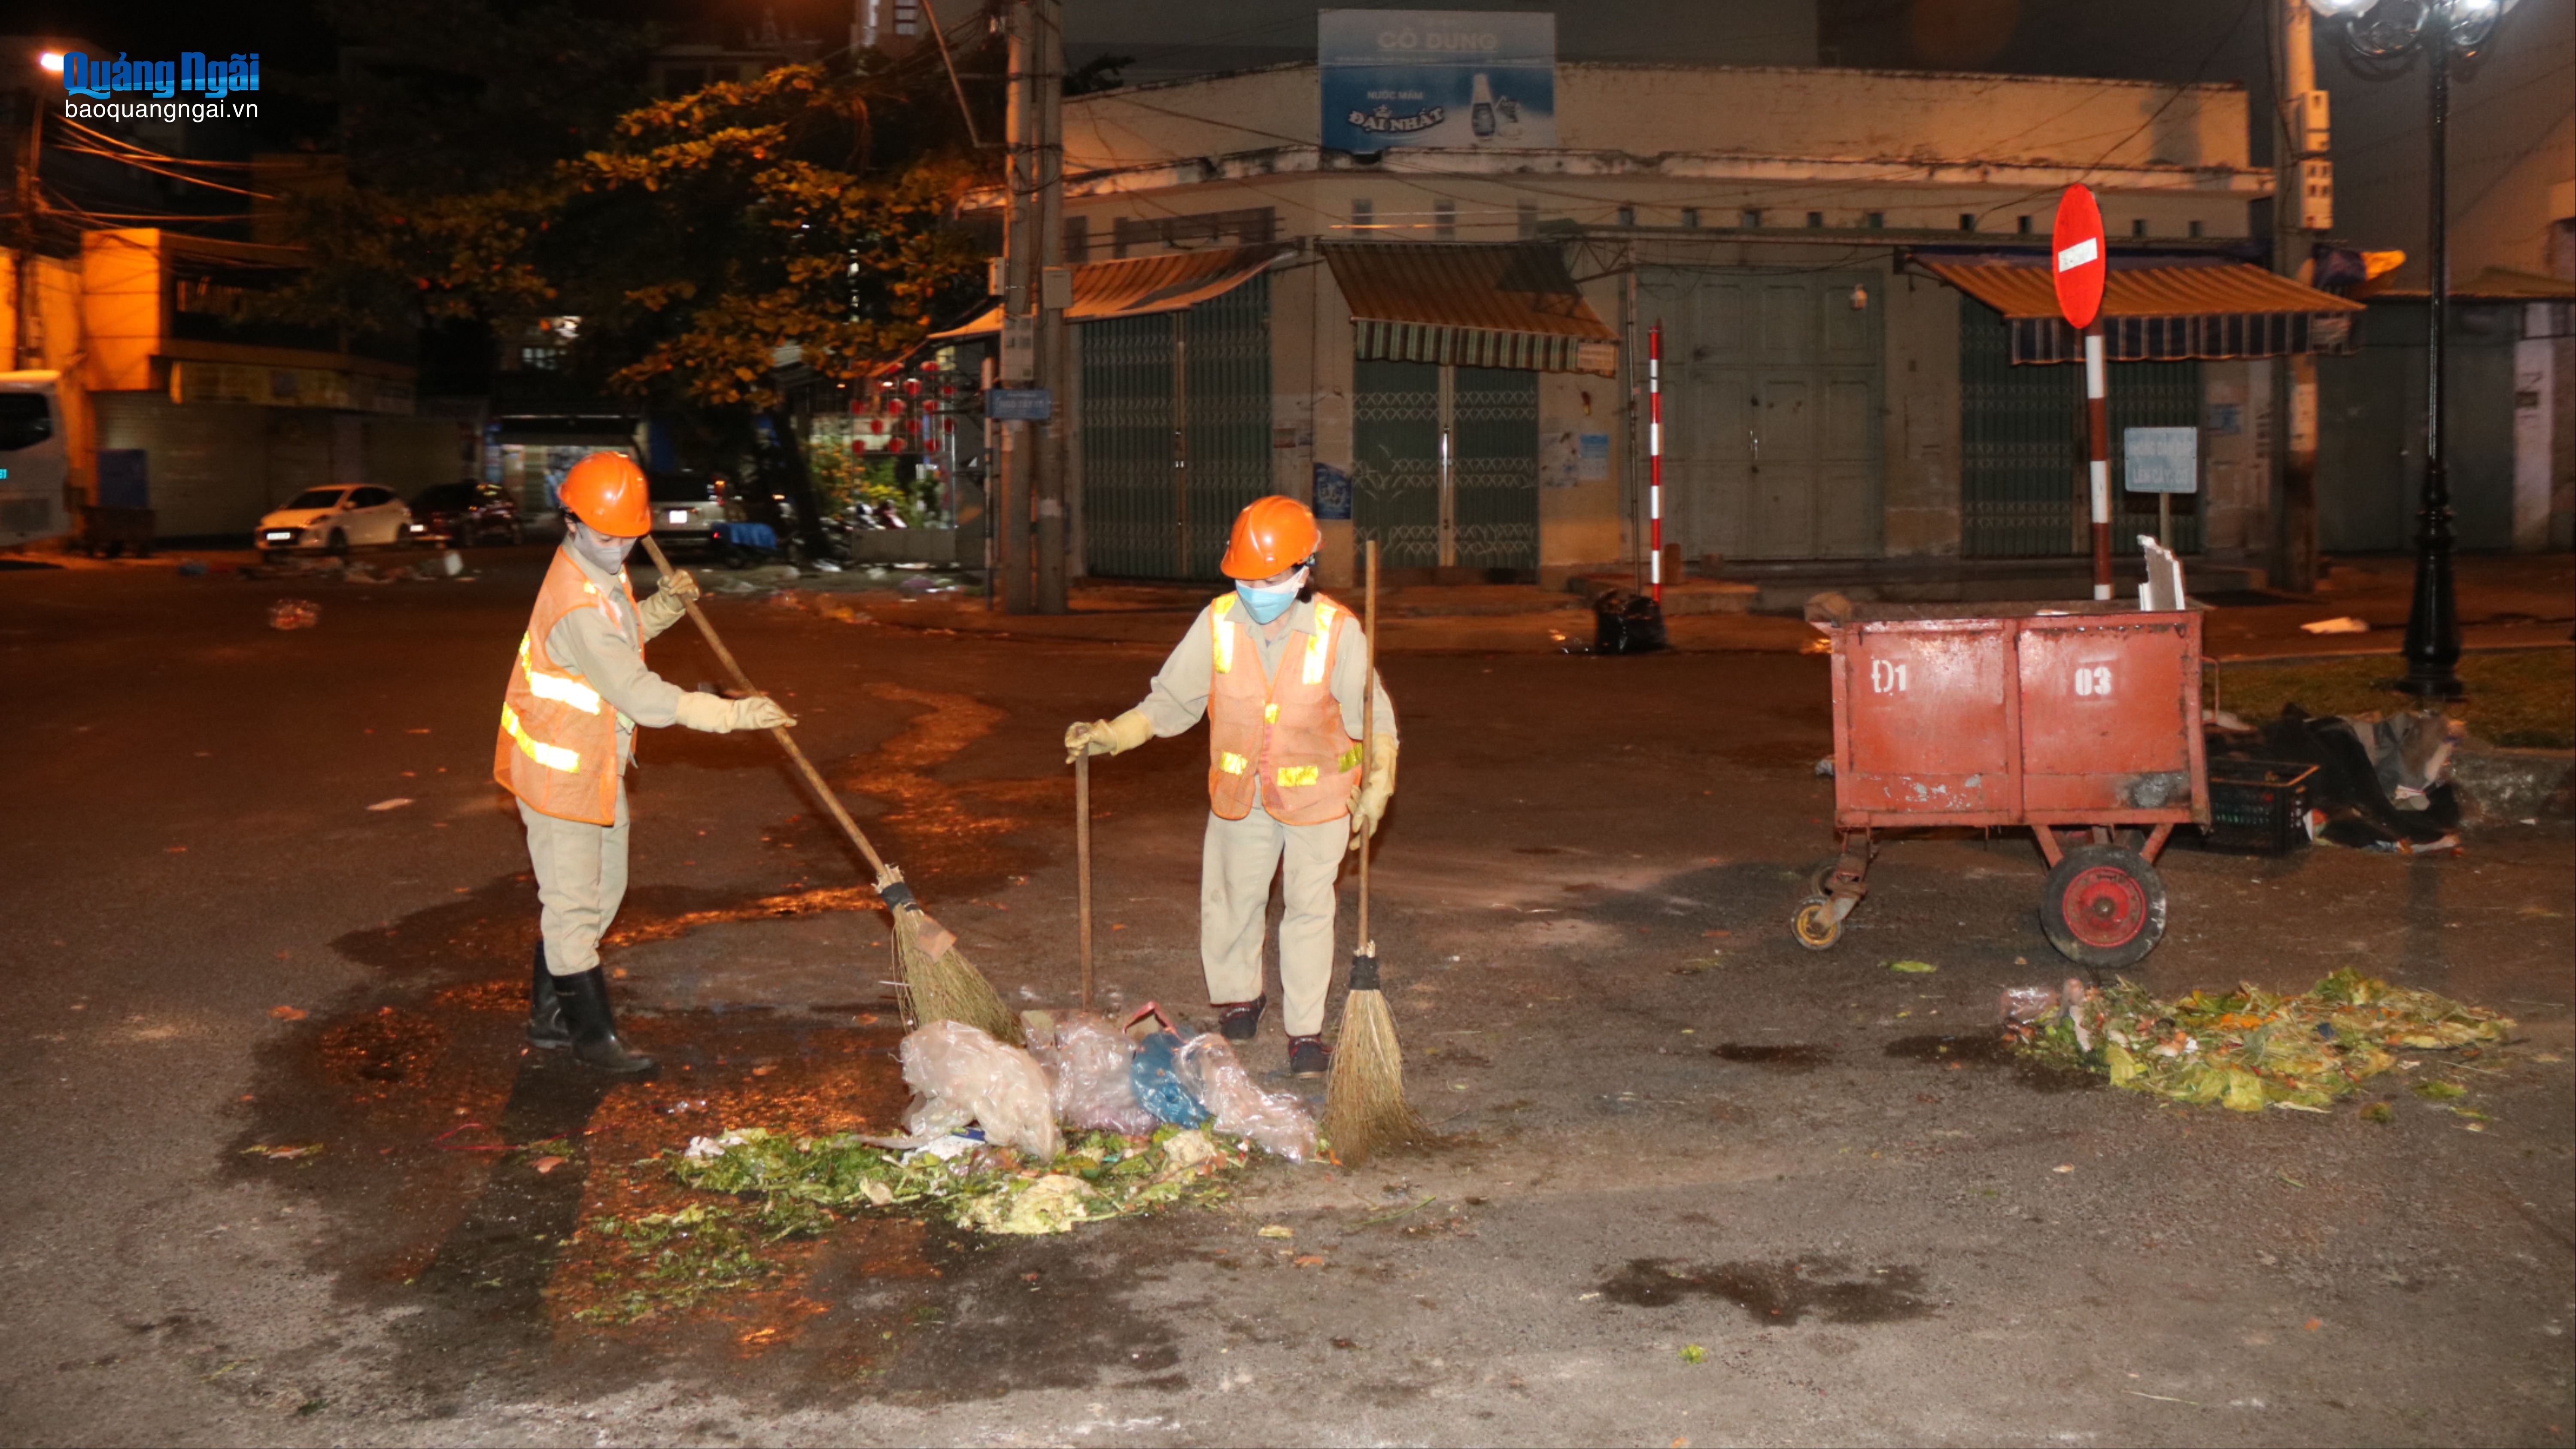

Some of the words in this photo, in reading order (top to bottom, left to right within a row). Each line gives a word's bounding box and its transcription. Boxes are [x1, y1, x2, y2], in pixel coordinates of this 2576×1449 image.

[1377, 27, 1417, 49] CÔ
[1426, 32, 1498, 49] DUNG
[1348, 110, 1385, 131] ĐẠI
[1390, 107, 1443, 131] NHẤT
[1871, 660, 1907, 693] Đ1
[2075, 666, 2112, 696] 03
